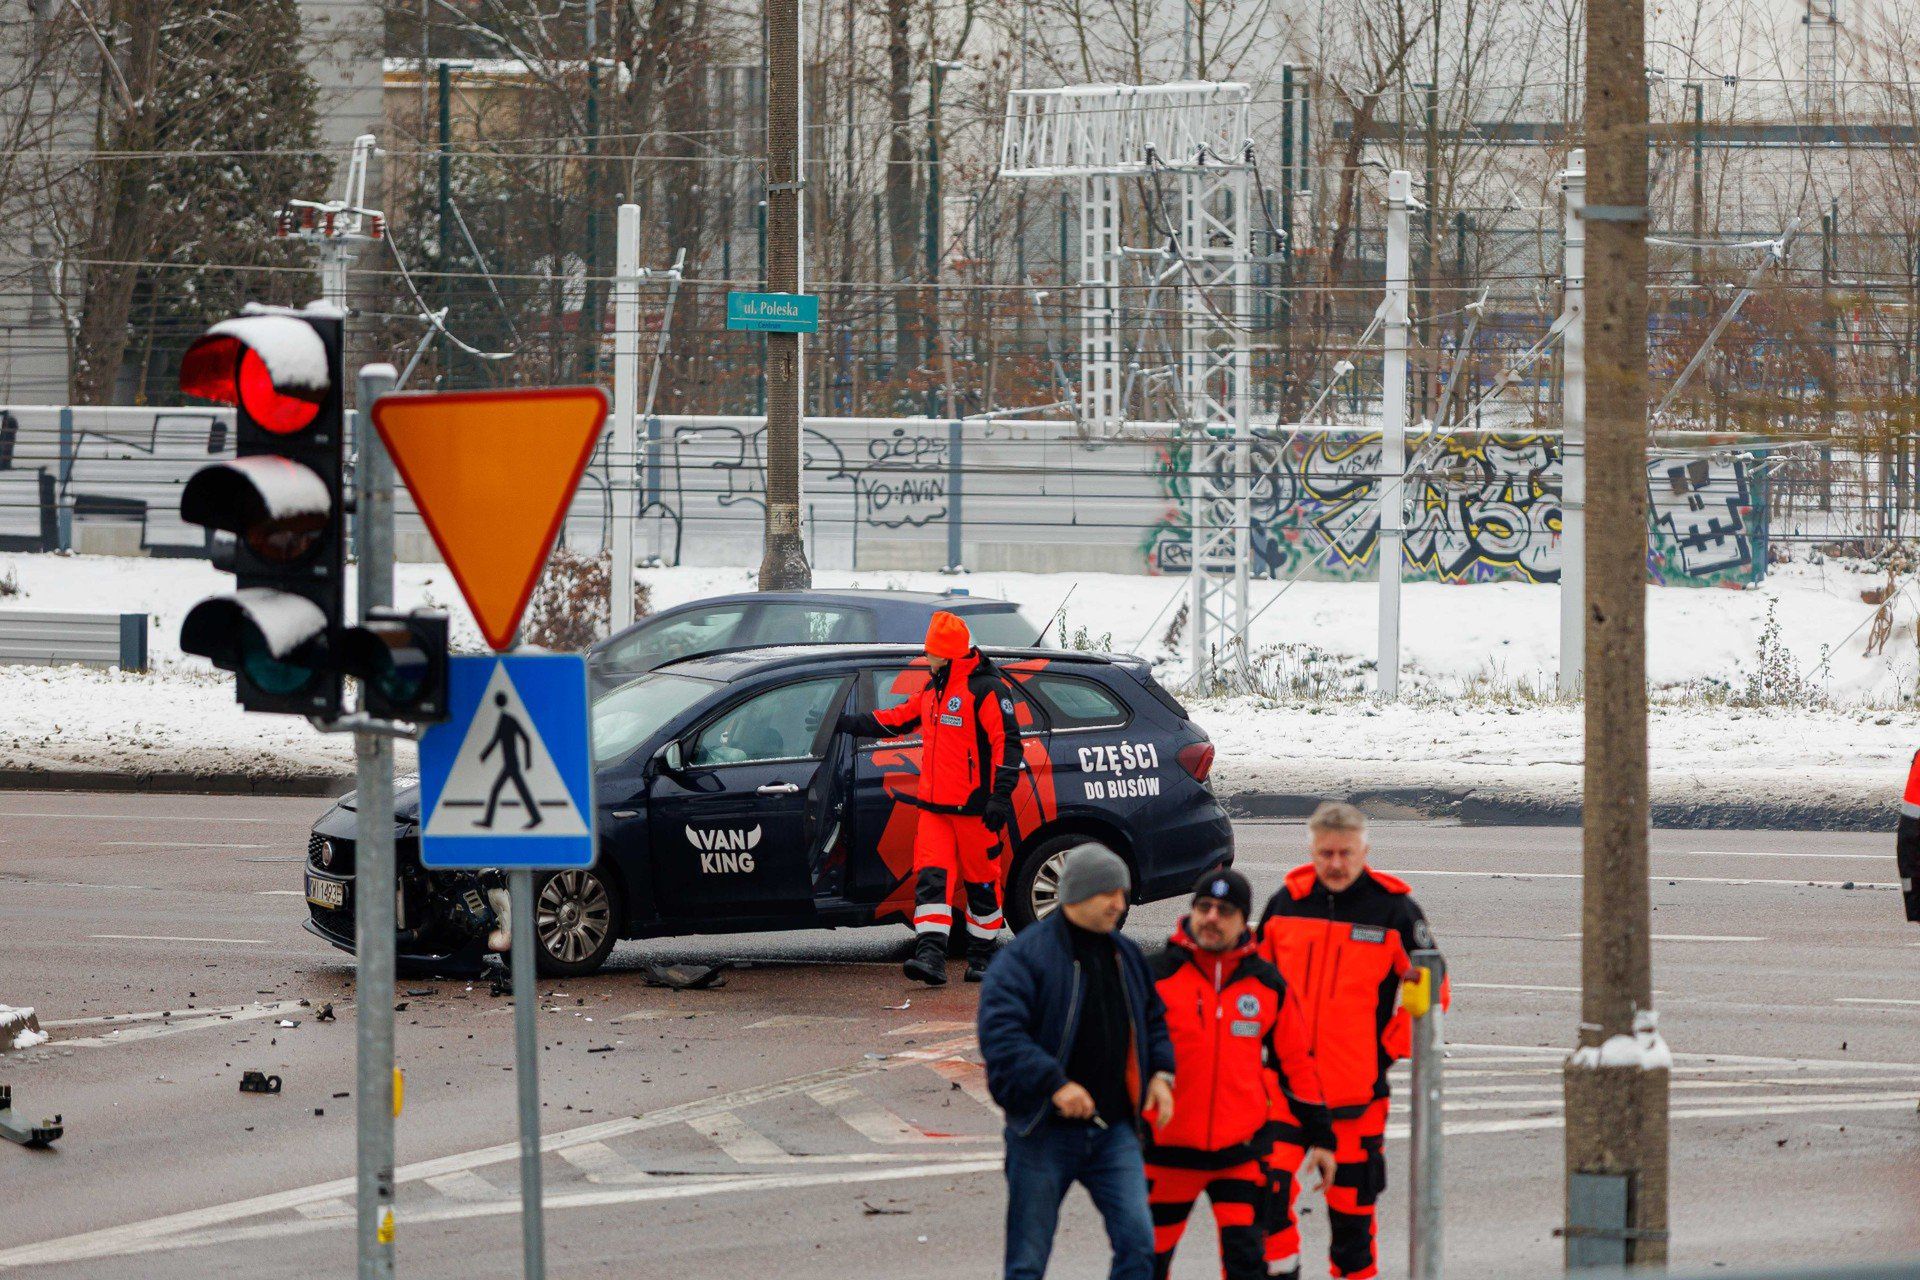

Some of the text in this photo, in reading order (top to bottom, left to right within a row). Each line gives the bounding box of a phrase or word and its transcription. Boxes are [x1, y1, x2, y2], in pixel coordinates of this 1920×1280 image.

[744, 300, 799, 317] ul. Poleska
[1078, 741, 1159, 776] CZĘŚCI
[1084, 775, 1160, 800] DO BUSÓW
[699, 829, 746, 850] VAN
[700, 852, 755, 873] KING
